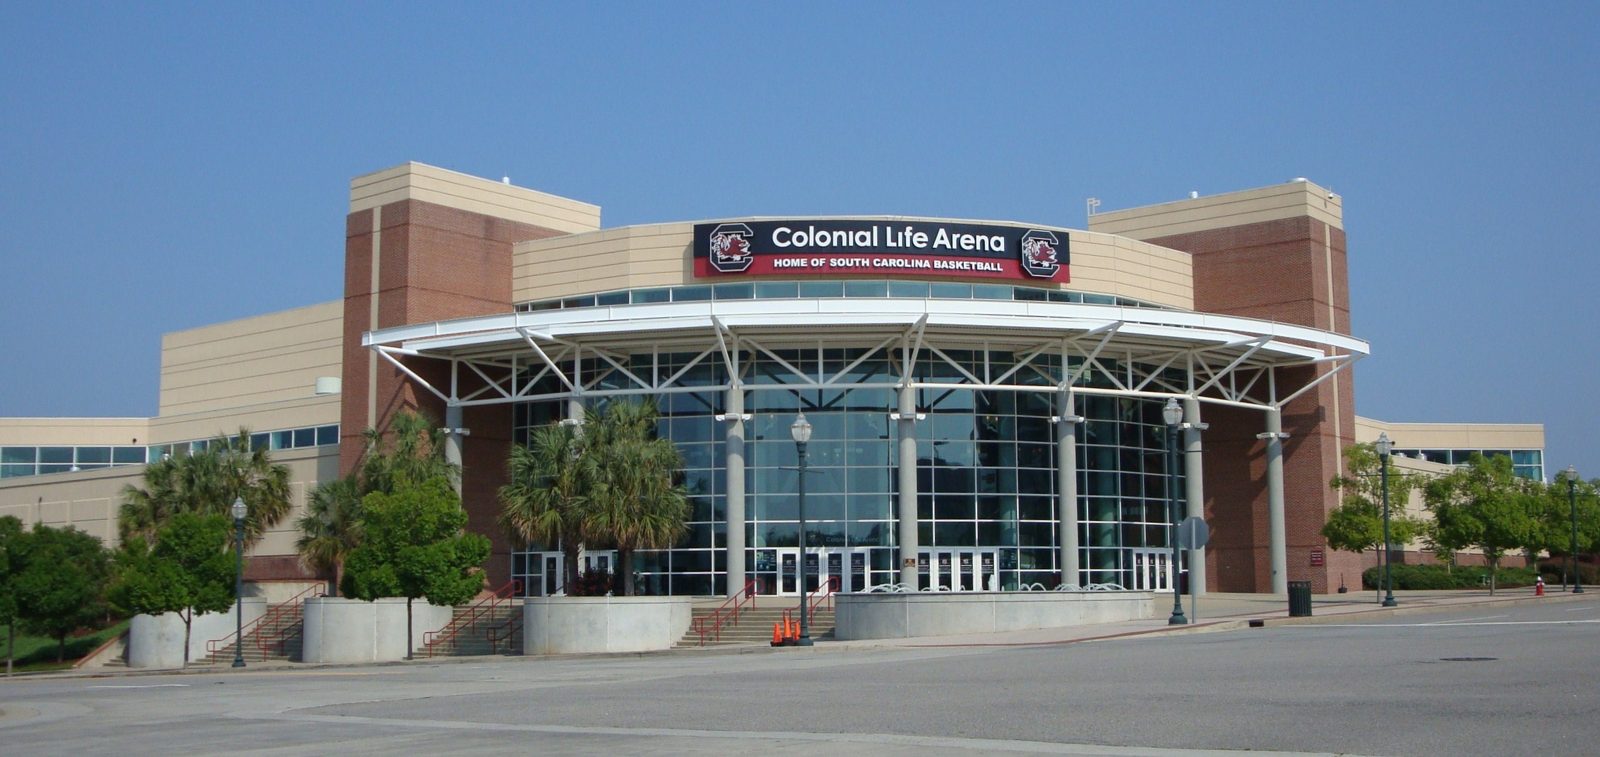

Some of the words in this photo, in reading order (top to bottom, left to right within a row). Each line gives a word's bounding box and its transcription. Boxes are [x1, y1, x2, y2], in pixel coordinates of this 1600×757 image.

[772, 225, 878, 248] Colonial
[886, 226, 929, 248] Life
[933, 228, 1005, 252] Arena
[773, 258, 809, 268] HOME
[810, 258, 827, 268] OF
[829, 257, 870, 267] SOUTH
[872, 257, 931, 269] CAROLINA
[933, 259, 1004, 272] BASKETBALL
